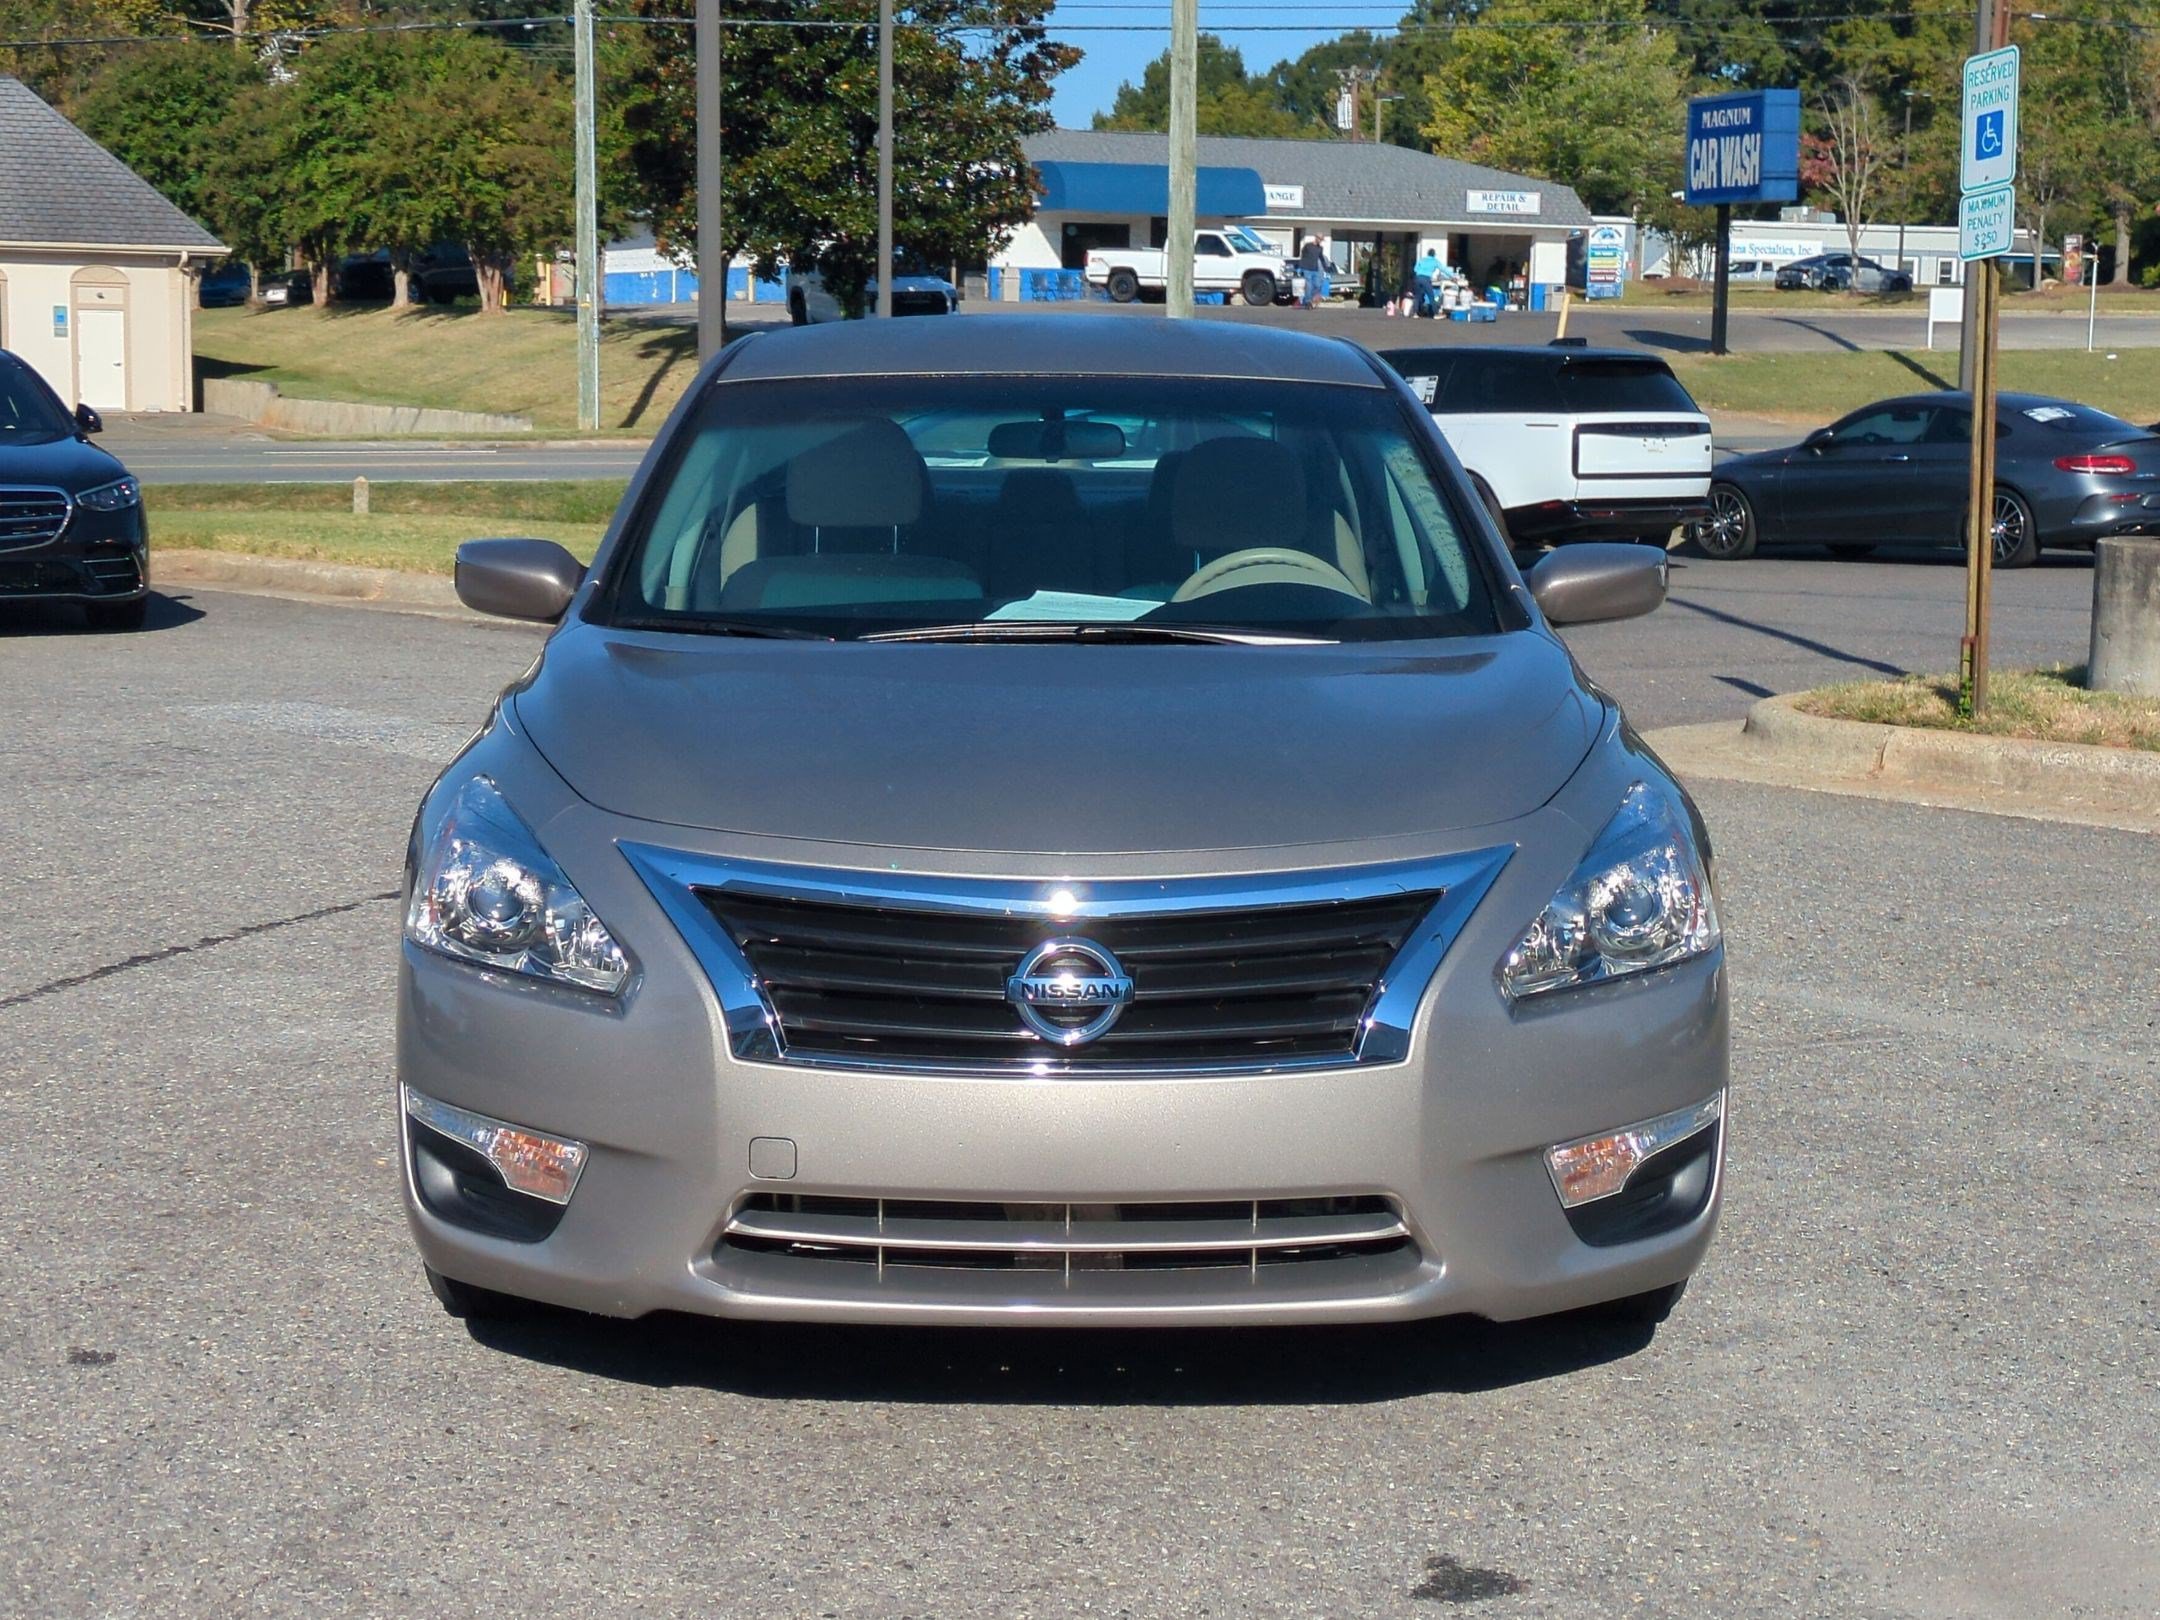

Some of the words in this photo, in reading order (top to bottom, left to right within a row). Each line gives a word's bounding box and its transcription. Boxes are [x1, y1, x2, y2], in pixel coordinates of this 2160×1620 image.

[1968, 61, 2014, 87] RESERVED
[1971, 85, 2010, 110] PARKING
[1701, 107, 1751, 128] MAGNUM
[1690, 138, 1717, 191] CAR
[1721, 133, 1761, 187] WASH
[1968, 194, 2006, 213] MAXIMUM
[1967, 211, 2004, 231] PENALTY
[1974, 230, 1998, 247] $250
[1021, 983, 1120, 999] NISSAN
